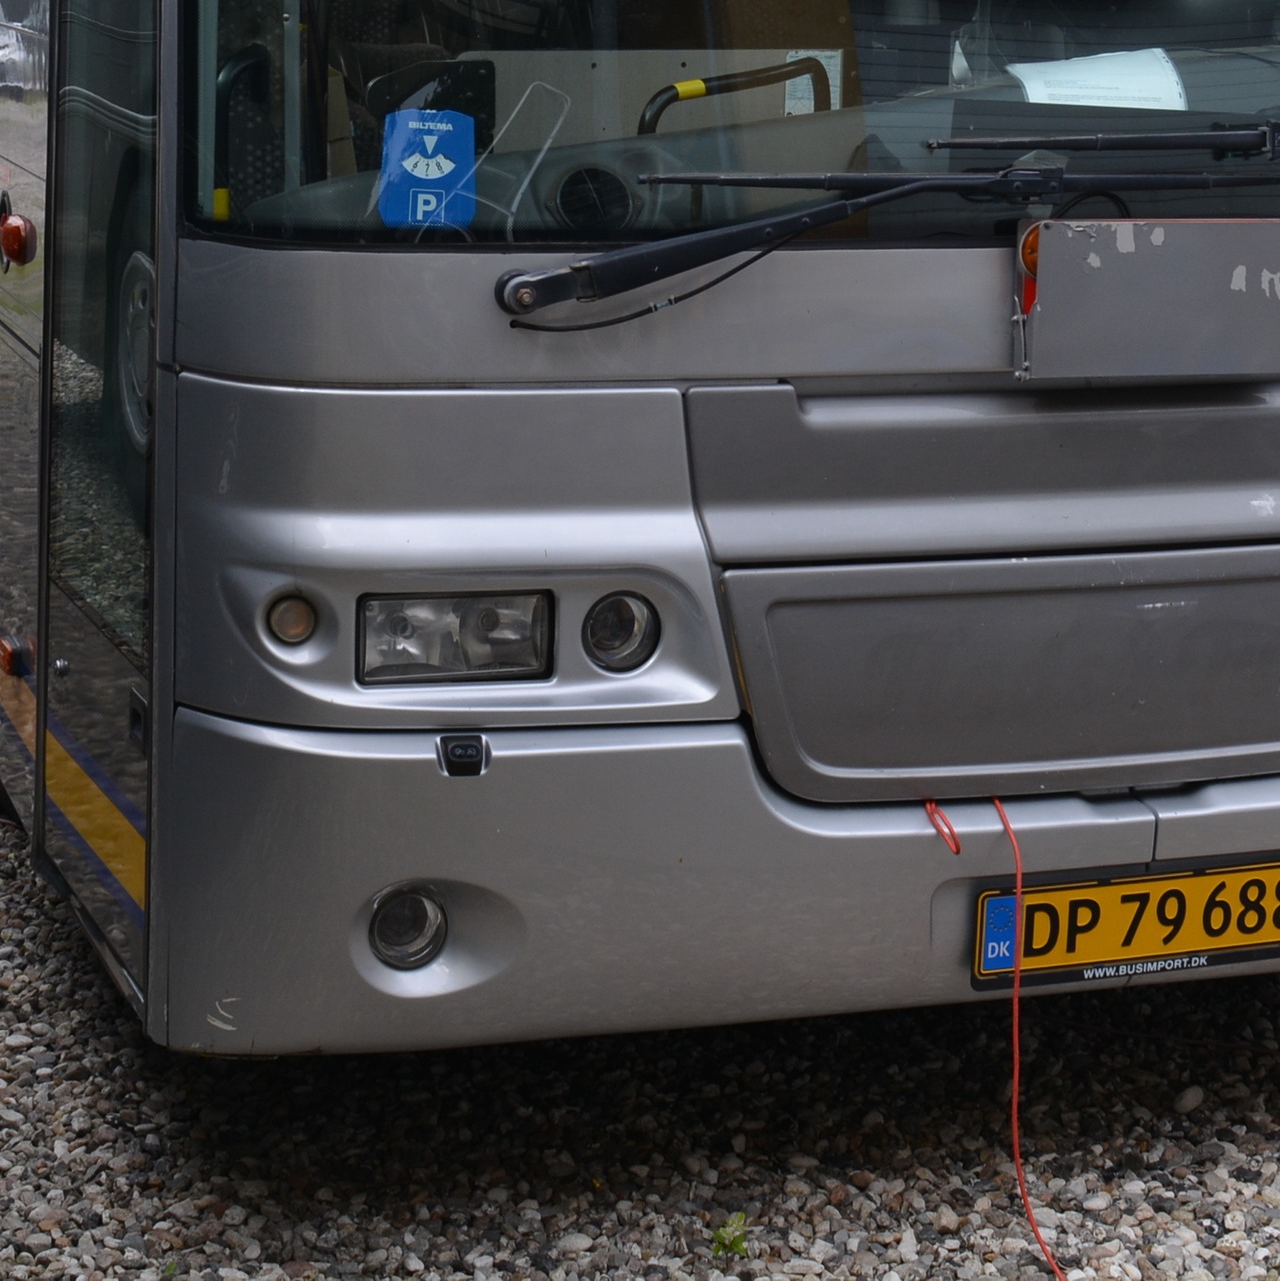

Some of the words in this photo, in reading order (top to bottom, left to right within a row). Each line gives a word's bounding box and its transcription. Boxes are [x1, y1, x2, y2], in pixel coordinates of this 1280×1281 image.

[408, 121, 453, 131] BILTEMA
[417, 194, 437, 220] P
[1023, 898, 1101, 958] DP
[1121, 889, 1187, 947] 79
[987, 940, 1011, 959] DK
[1083, 956, 1208, 980] WWW.BUSIMPORT.DK
